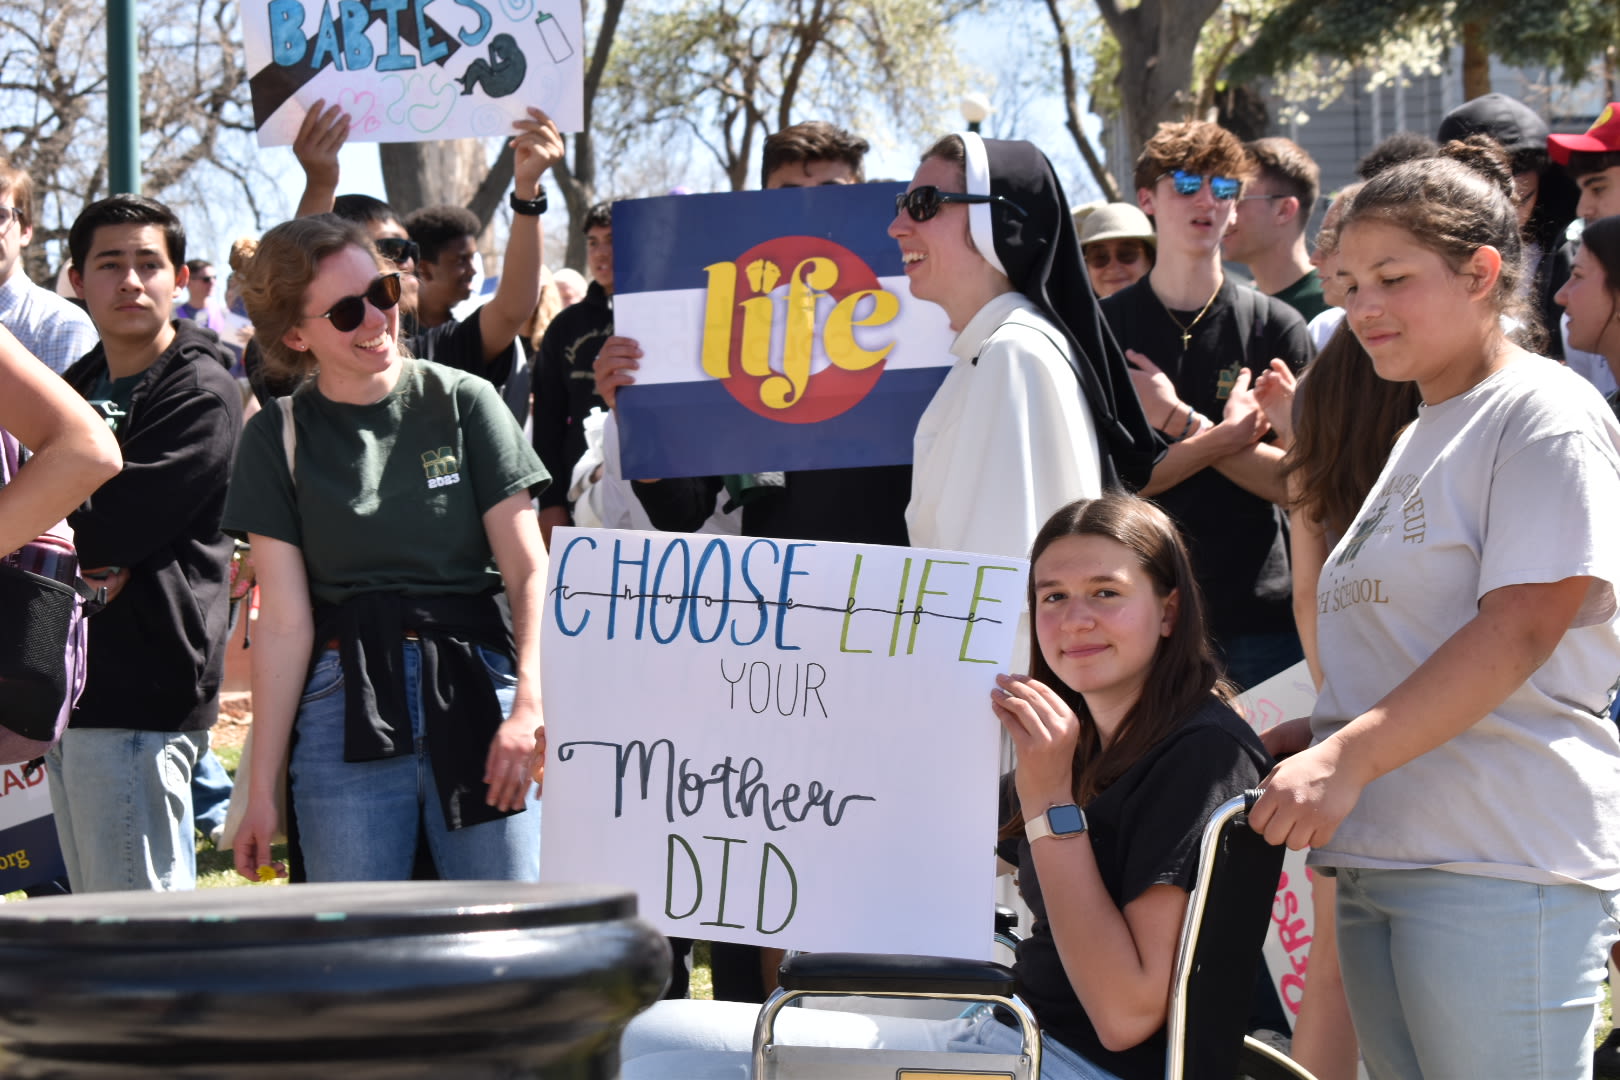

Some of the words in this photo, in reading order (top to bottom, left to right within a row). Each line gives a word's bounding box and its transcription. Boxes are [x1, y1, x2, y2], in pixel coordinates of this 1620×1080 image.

[268, 0, 492, 71] BABIES
[702, 256, 900, 409] life
[427, 472, 460, 489] 2023
[555, 536, 818, 650] CHOOSE
[840, 553, 1018, 664] LIFE
[1332, 578, 1389, 612] SCHOOL
[721, 658, 828, 719] YOUR
[0, 762, 48, 797] AD
[557, 738, 877, 832] Mother
[664, 833, 798, 935] DID
